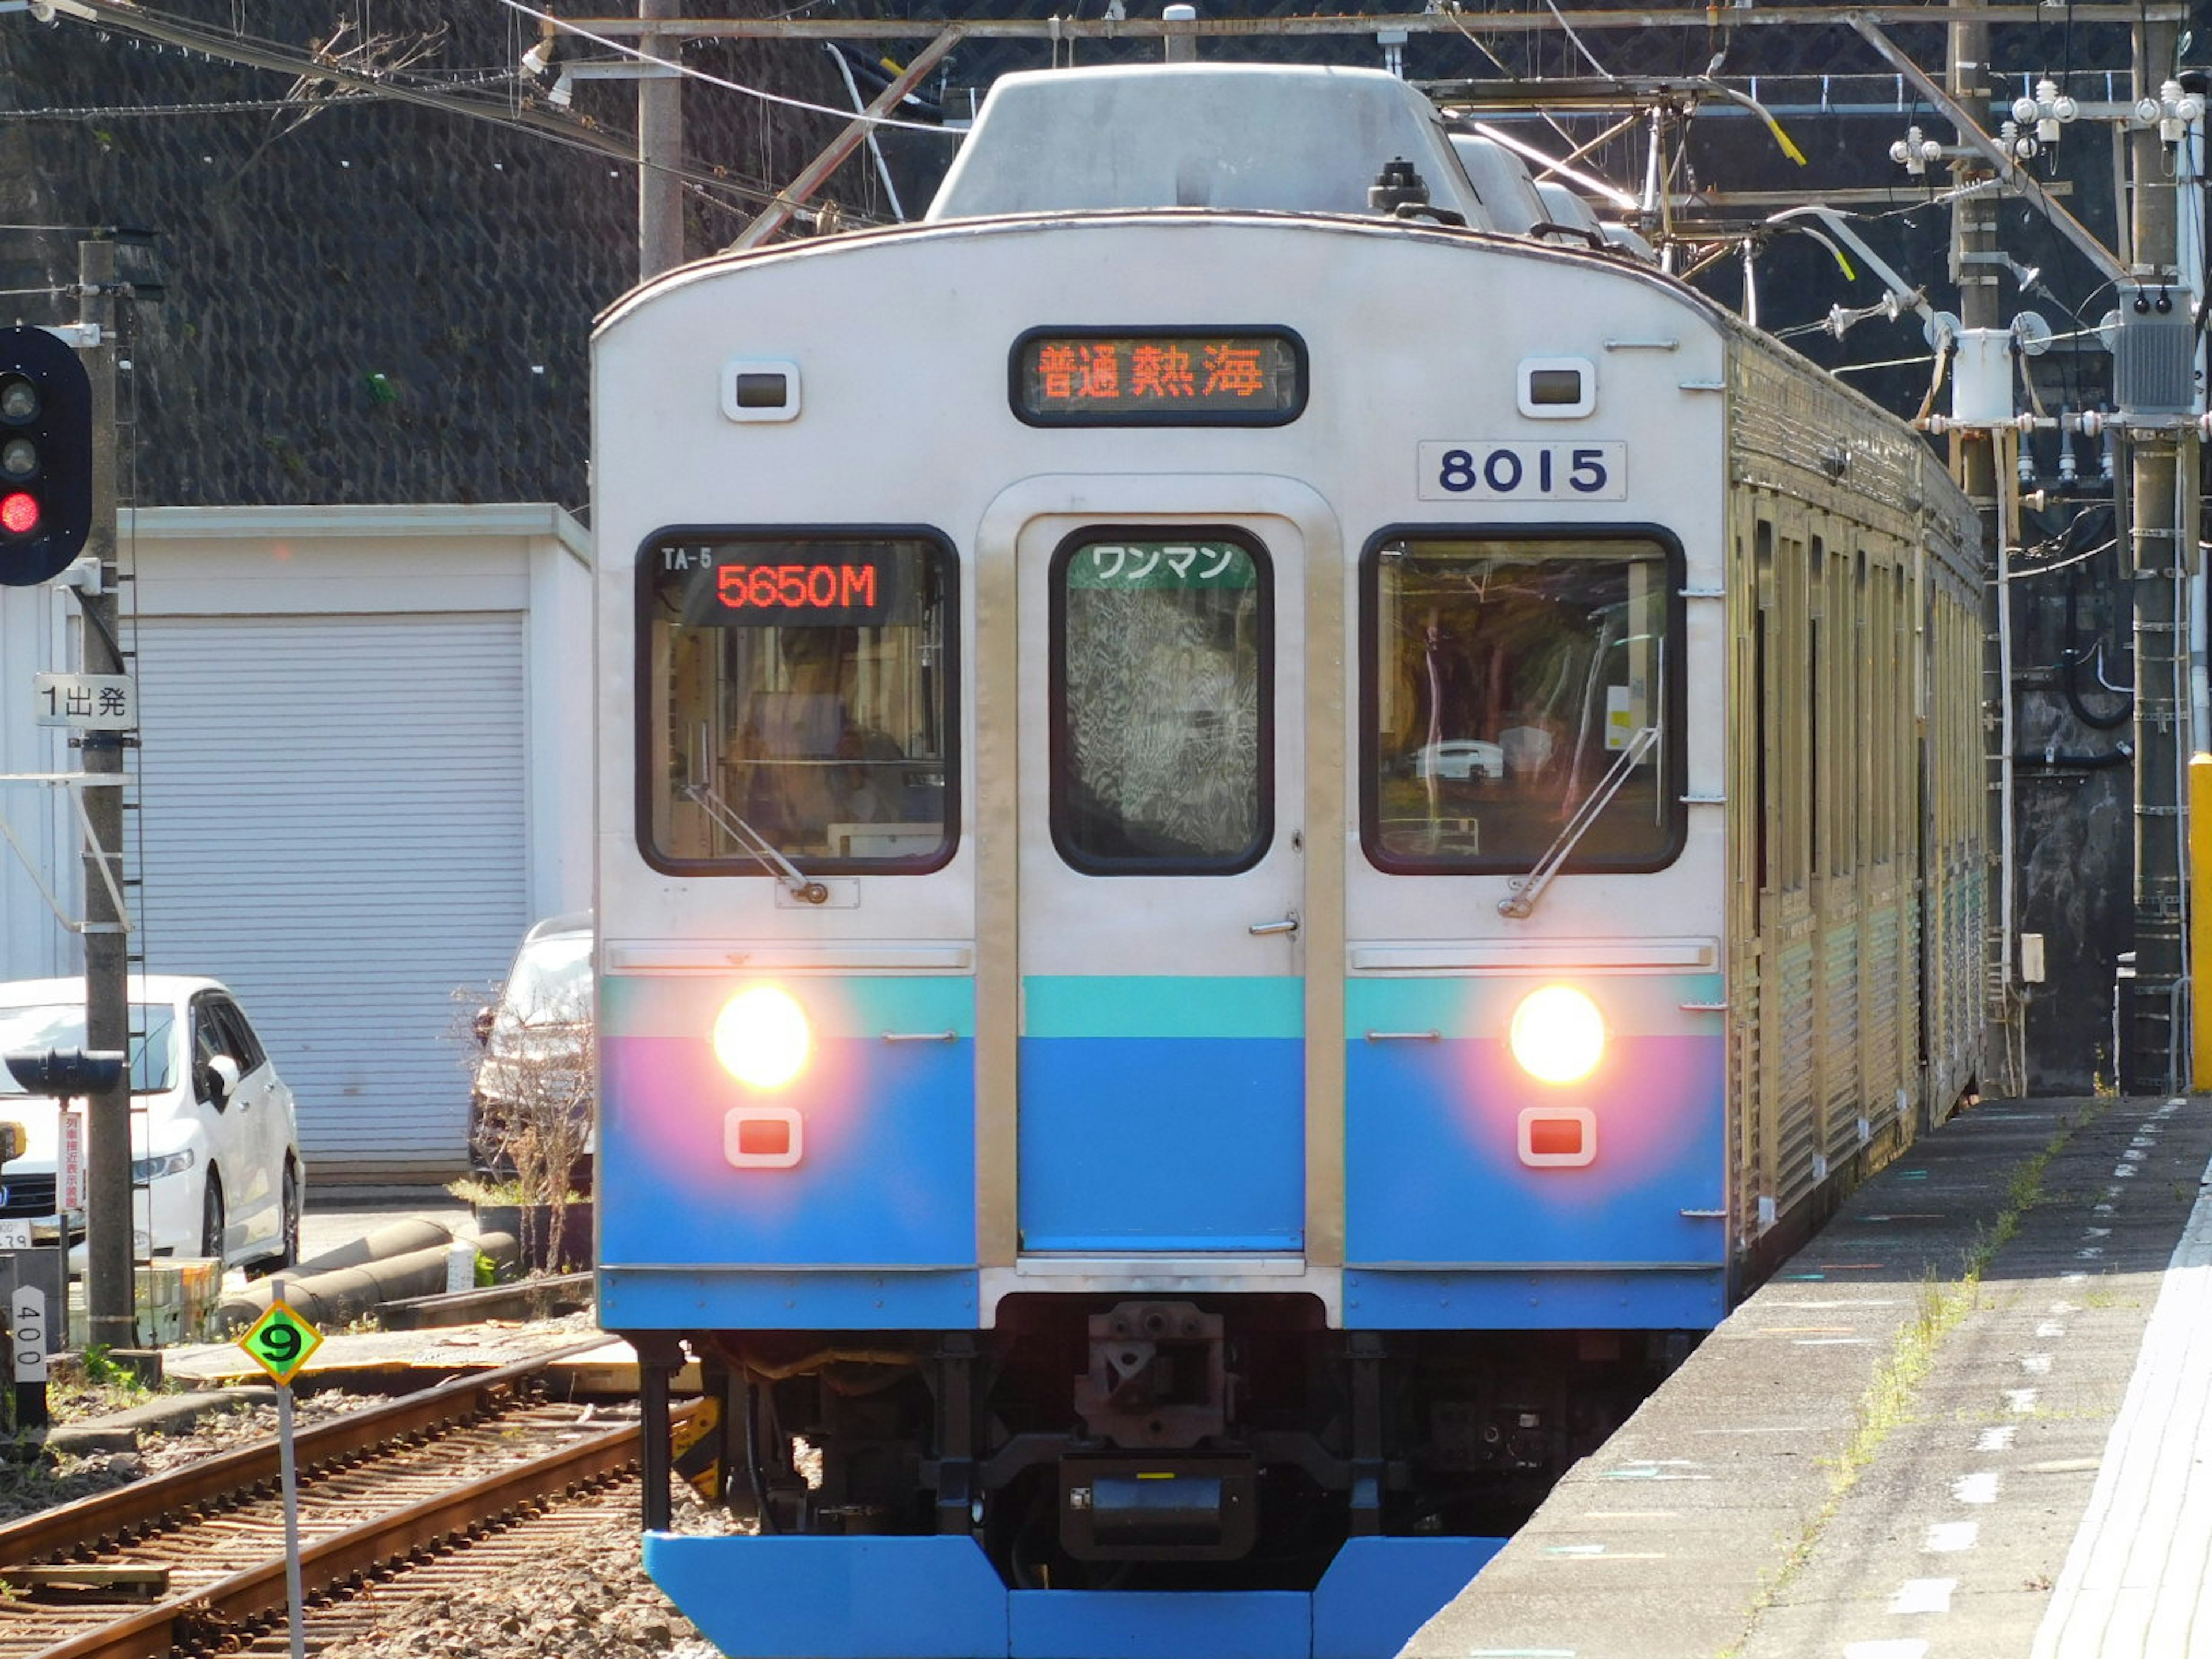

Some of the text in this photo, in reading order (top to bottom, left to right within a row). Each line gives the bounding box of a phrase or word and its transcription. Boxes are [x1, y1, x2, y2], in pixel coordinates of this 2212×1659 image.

[1039, 344, 1263, 397] 普通 熱海
[1439, 449, 1607, 492] 8015
[661, 547, 713, 569] TA-5
[1093, 546, 1233, 578] ワンマン
[718, 564, 874, 608] 5650M
[41, 685, 126, 717] 1出発
[17, 1306, 40, 1364] 400
[260, 1324, 301, 1361] 9
